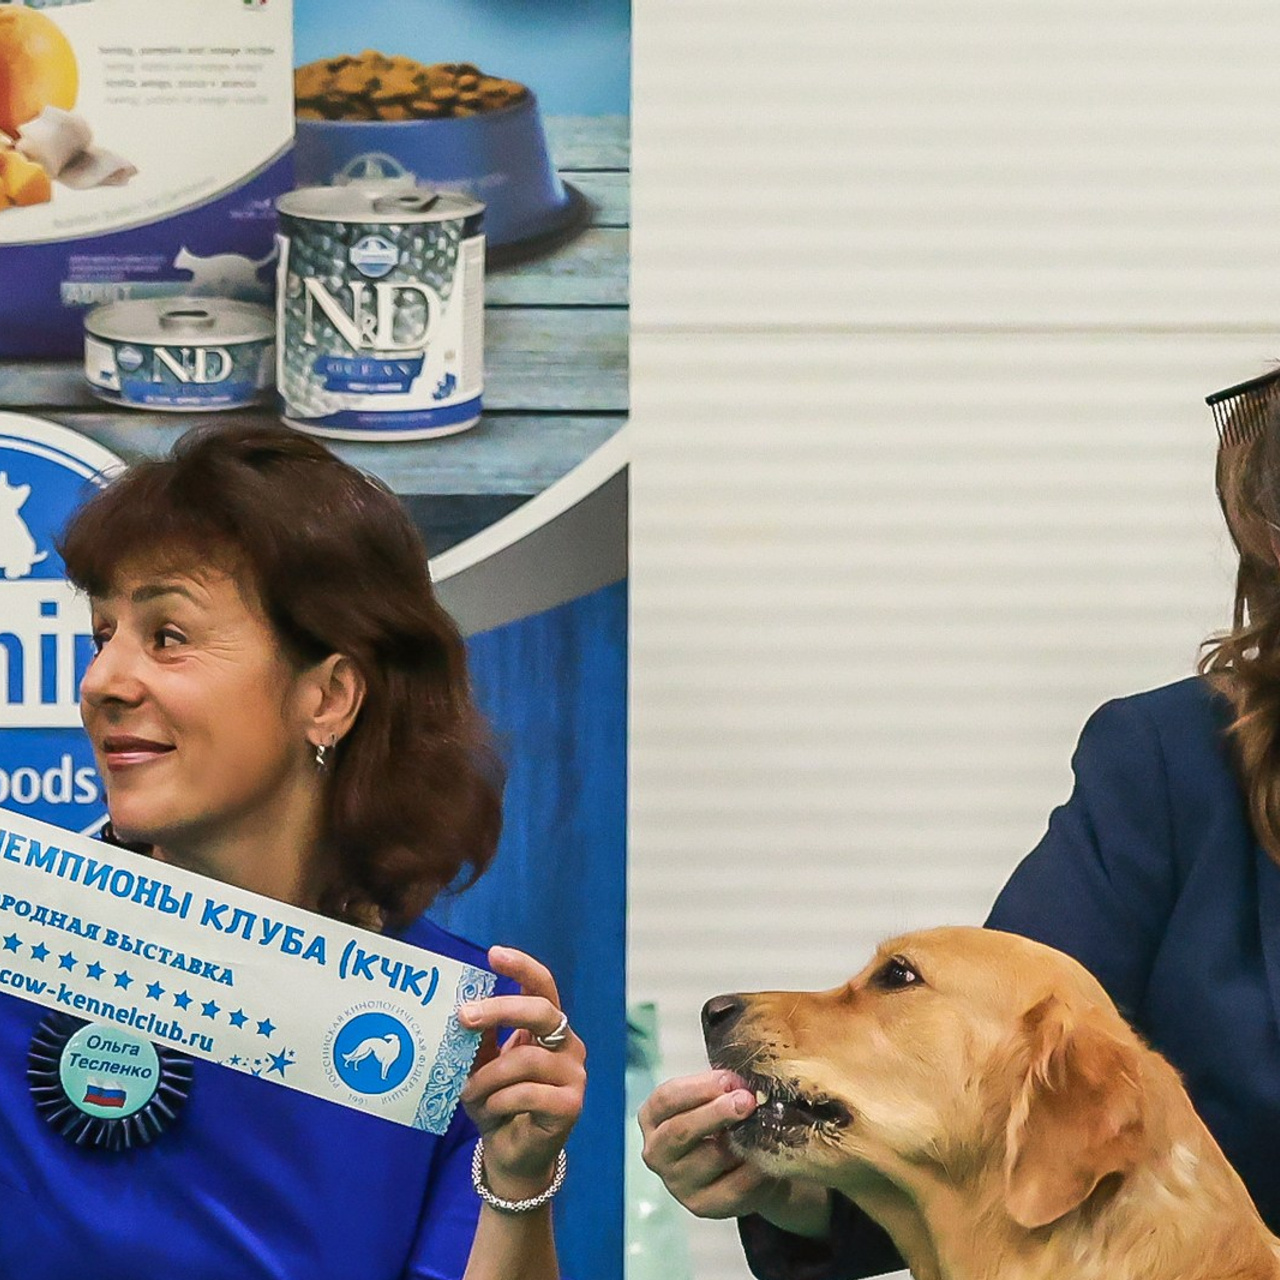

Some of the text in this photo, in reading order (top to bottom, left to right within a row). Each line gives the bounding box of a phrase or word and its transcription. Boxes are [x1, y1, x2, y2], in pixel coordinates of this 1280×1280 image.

[0, 829, 439, 1006] ЕМПИОНЫ КЛУБА (КЧК)
[103, 928, 234, 987] ВЫСТАВКА
[69, 1052, 152, 1079] Тесленко
[86, 1034, 141, 1056] Ольга
